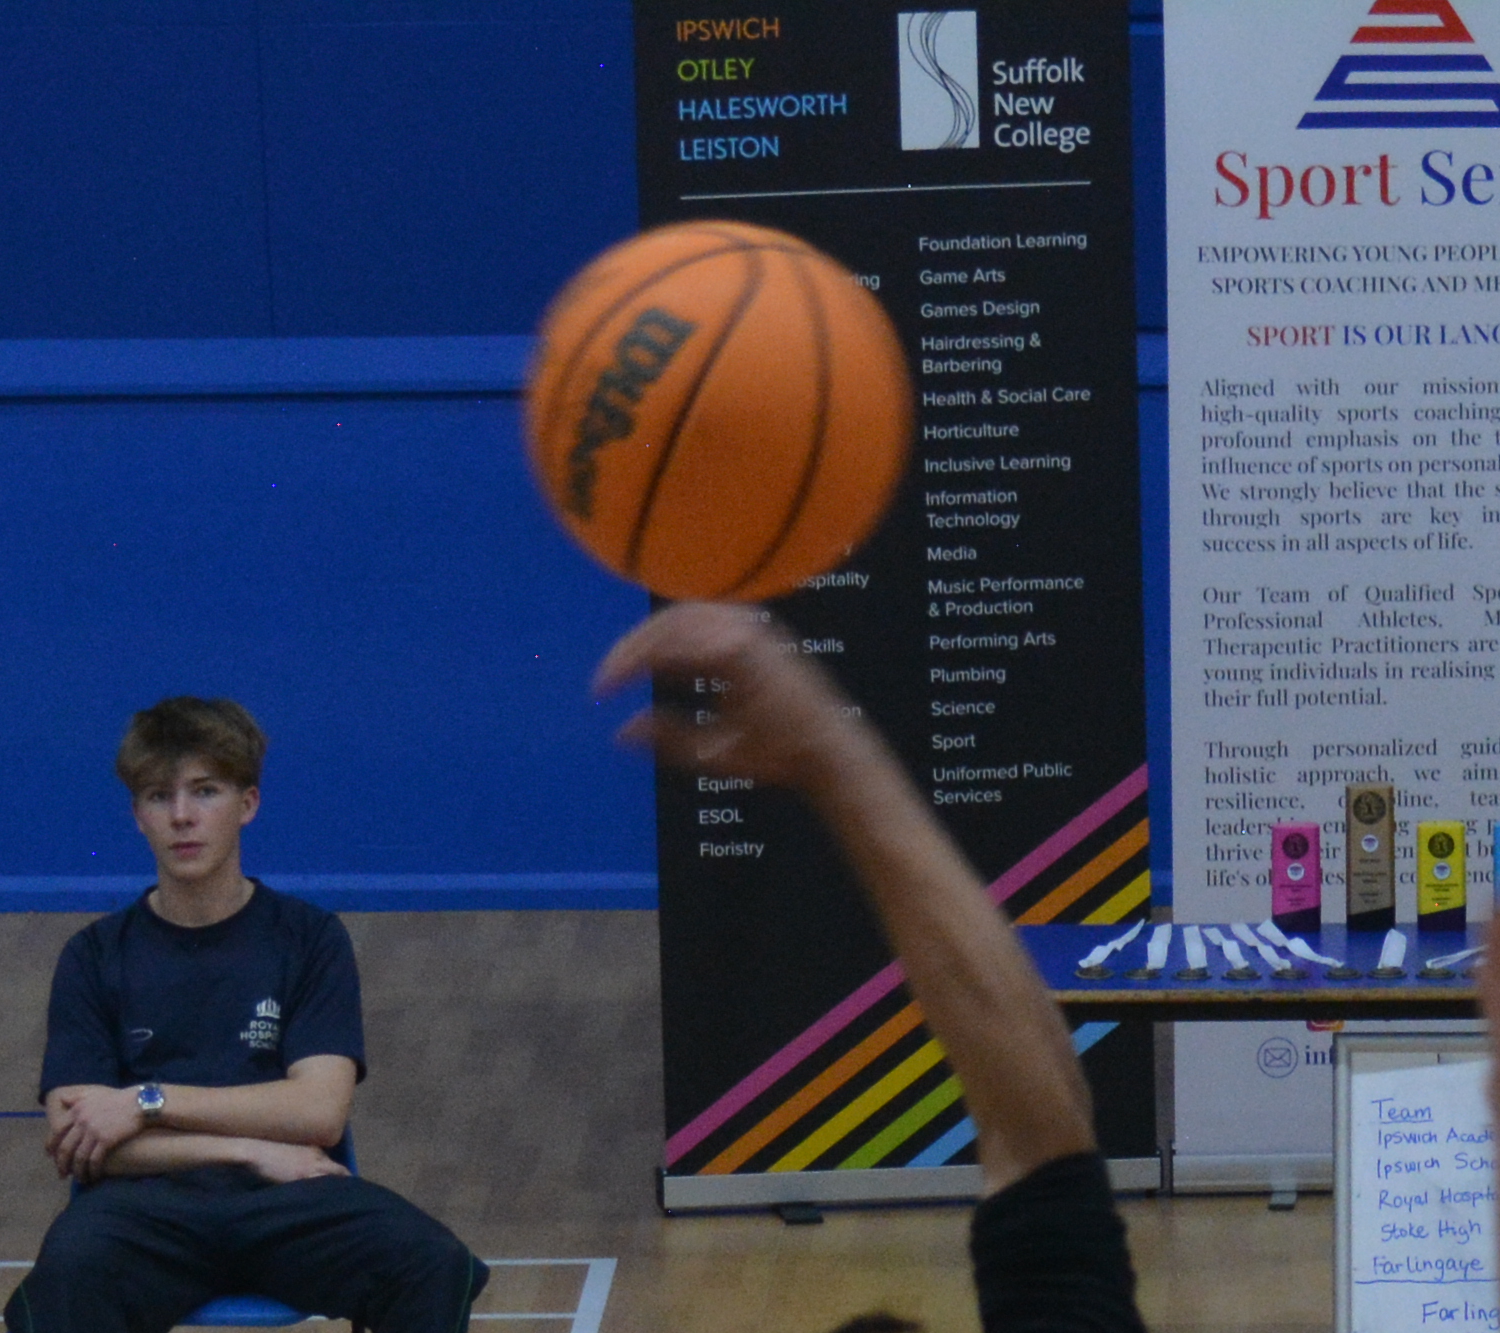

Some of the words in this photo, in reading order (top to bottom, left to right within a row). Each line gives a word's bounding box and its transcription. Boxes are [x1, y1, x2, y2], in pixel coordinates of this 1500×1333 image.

[676, 16, 780, 42] IPSWICH
[676, 57, 754, 82] OTLEY
[992, 57, 1085, 86] Suffolk
[677, 93, 847, 121] HALESWORTH
[993, 92, 1055, 116] New
[679, 135, 779, 161] LEISTON
[993, 124, 1091, 154] College
[1213, 149, 1401, 220] Sport
[917, 235, 1012, 252] Foundation
[1015, 233, 1088, 250] Learning
[1197, 245, 1348, 265] EMPOWERING
[1351, 244, 1427, 264] YOUNG
[918, 269, 969, 286] Game
[972, 267, 1007, 283] Arts
[1211, 277, 1295, 296] SPORTS
[1299, 276, 1418, 295] COACHING
[1421, 275, 1468, 294] AND
[919, 302, 979, 319] Games
[981, 300, 1041, 319] Design
[920, 334, 1026, 352] Hairdressing
[1028, 332, 1042, 348] &
[1246, 324, 1336, 348] SPORT
[1343, 324, 1367, 347] IS
[1373, 323, 1432, 347] OUR
[921, 358, 1003, 375] Barbering
[922, 390, 977, 407] Health
[980, 388, 993, 405] &
[997, 388, 1048, 405] Social
[1051, 386, 1092, 403] Care
[1201, 378, 1276, 400] Aligned
[1296, 377, 1340, 396] with
[1363, 382, 1399, 396] our
[1422, 376, 1500, 396] mission
[1201, 403, 1320, 427] high-quality
[1336, 404, 1399, 426] sports
[923, 422, 1020, 440] Horticulture
[1201, 430, 1292, 452] profound
[1305, 428, 1399, 452] emphasis
[1412, 433, 1437, 447] on
[1450, 427, 1482, 447] the
[924, 457, 996, 473] Inclusive
[999, 454, 1072, 472] Learning
[924, 489, 1018, 506] Information
[1201, 483, 1230, 501] We
[1239, 481, 1318, 502] strongly
[1328, 480, 1398, 499] believe
[1406, 480, 1445, 499] that
[1454, 479, 1485, 498] the
[926, 511, 1021, 530] Technology
[1202, 507, 1281, 529] through
[1299, 508, 1362, 530] sports
[1380, 511, 1413, 525] are
[1429, 505, 1460, 528] key
[926, 546, 978, 562] Media
[927, 579, 975, 595] Music
[979, 576, 1085, 593] Performance
[927, 601, 941, 618] &
[944, 600, 1034, 616] Production
[801, 636, 845, 654] Skills
[928, 634, 1019, 651] Performing
[1022, 630, 1057, 646] Arts
[929, 667, 1007, 685] Plumbing
[930, 700, 996, 717] Science
[931, 733, 976, 752] Sport
[932, 764, 1019, 783] Uniformed
[1022, 762, 1072, 778] Public
[697, 776, 754, 793] Equine
[933, 789, 1004, 806] Services
[698, 807, 743, 825] ESOL
[698, 841, 765, 858] Floristry
[1372, 1098, 1433, 1120] Team
[1378, 1129, 1438, 1150] Ipswich
[1377, 1157, 1441, 1180] Ipswich
[1378, 1189, 1429, 1213] Royal
[1381, 1223, 1430, 1242] Stoke
[1438, 1219, 1482, 1245] High
[1372, 1255, 1484, 1282] Farlingaye
